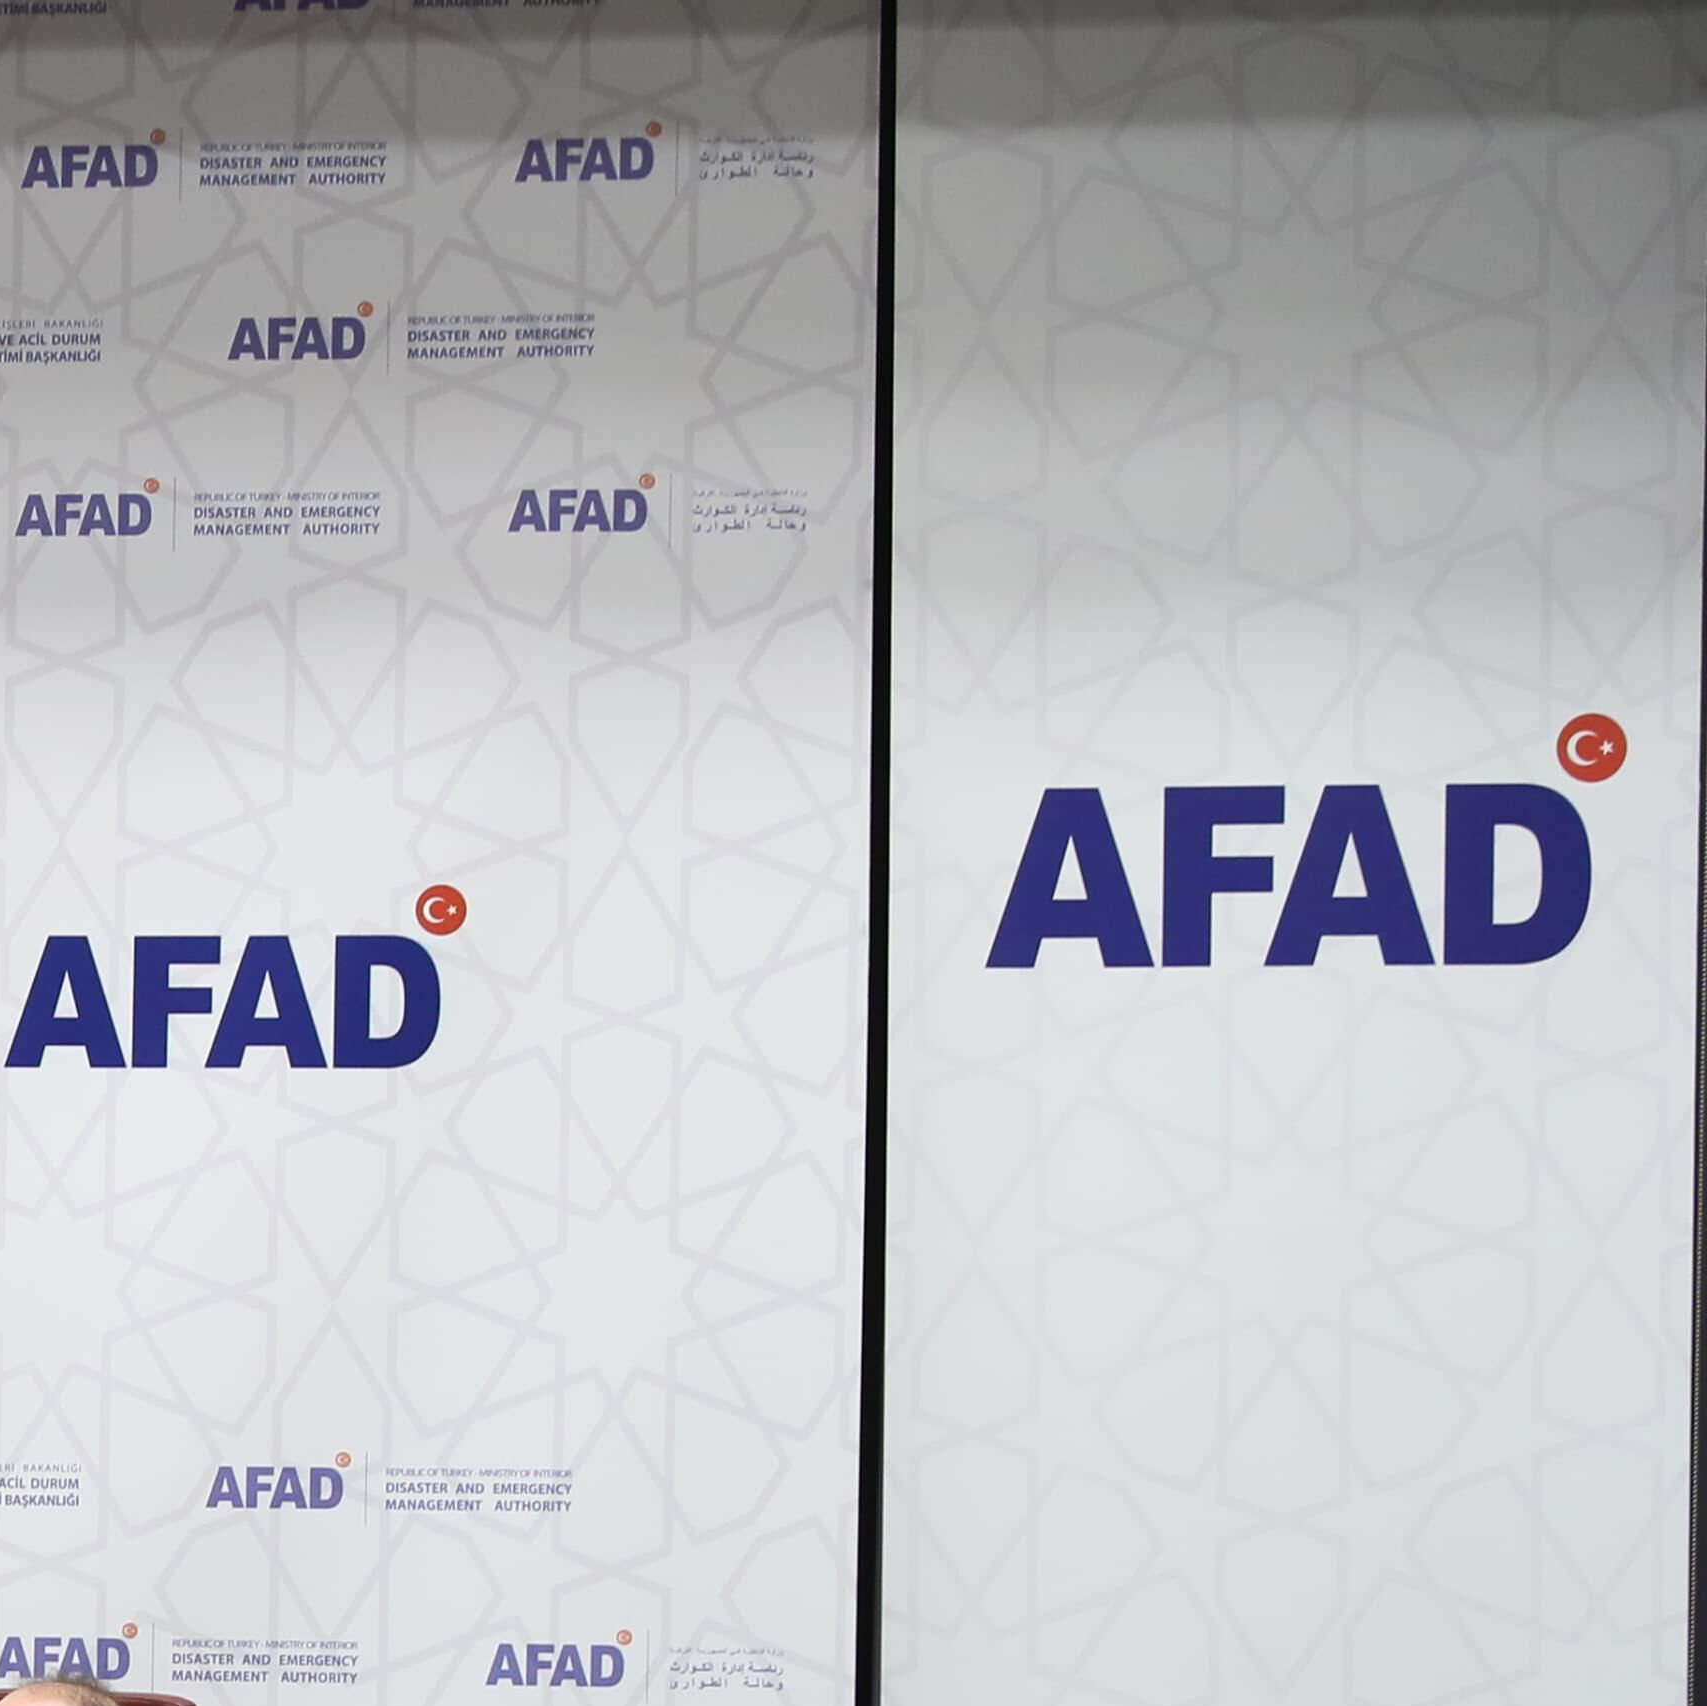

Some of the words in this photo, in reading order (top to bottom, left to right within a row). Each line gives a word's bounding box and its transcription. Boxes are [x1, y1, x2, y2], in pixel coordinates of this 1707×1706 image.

[19, 145, 157, 188] AFAD
[199, 157, 262, 171] DISASTER
[269, 156, 300, 169] AND
[306, 155, 386, 169] EMERGENCY
[199, 172, 296, 188] MANAGEMENT
[308, 172, 386, 186] AUTHORITY
[513, 138, 653, 181] AFAD
[18, 332, 47, 346] ACİL
[51, 332, 101, 346] DURUM
[226, 318, 365, 361] AFAD
[14, 495, 152, 538] AFAD
[507, 490, 648, 534] AFAD
[986, 784, 1592, 969] AFAD
[5, 934, 442, 1070] AFAD
[30, 1477, 80, 1490] DURUM
[207, 1466, 344, 1509] AFAD
[484, 1643, 624, 1687] AFAD
